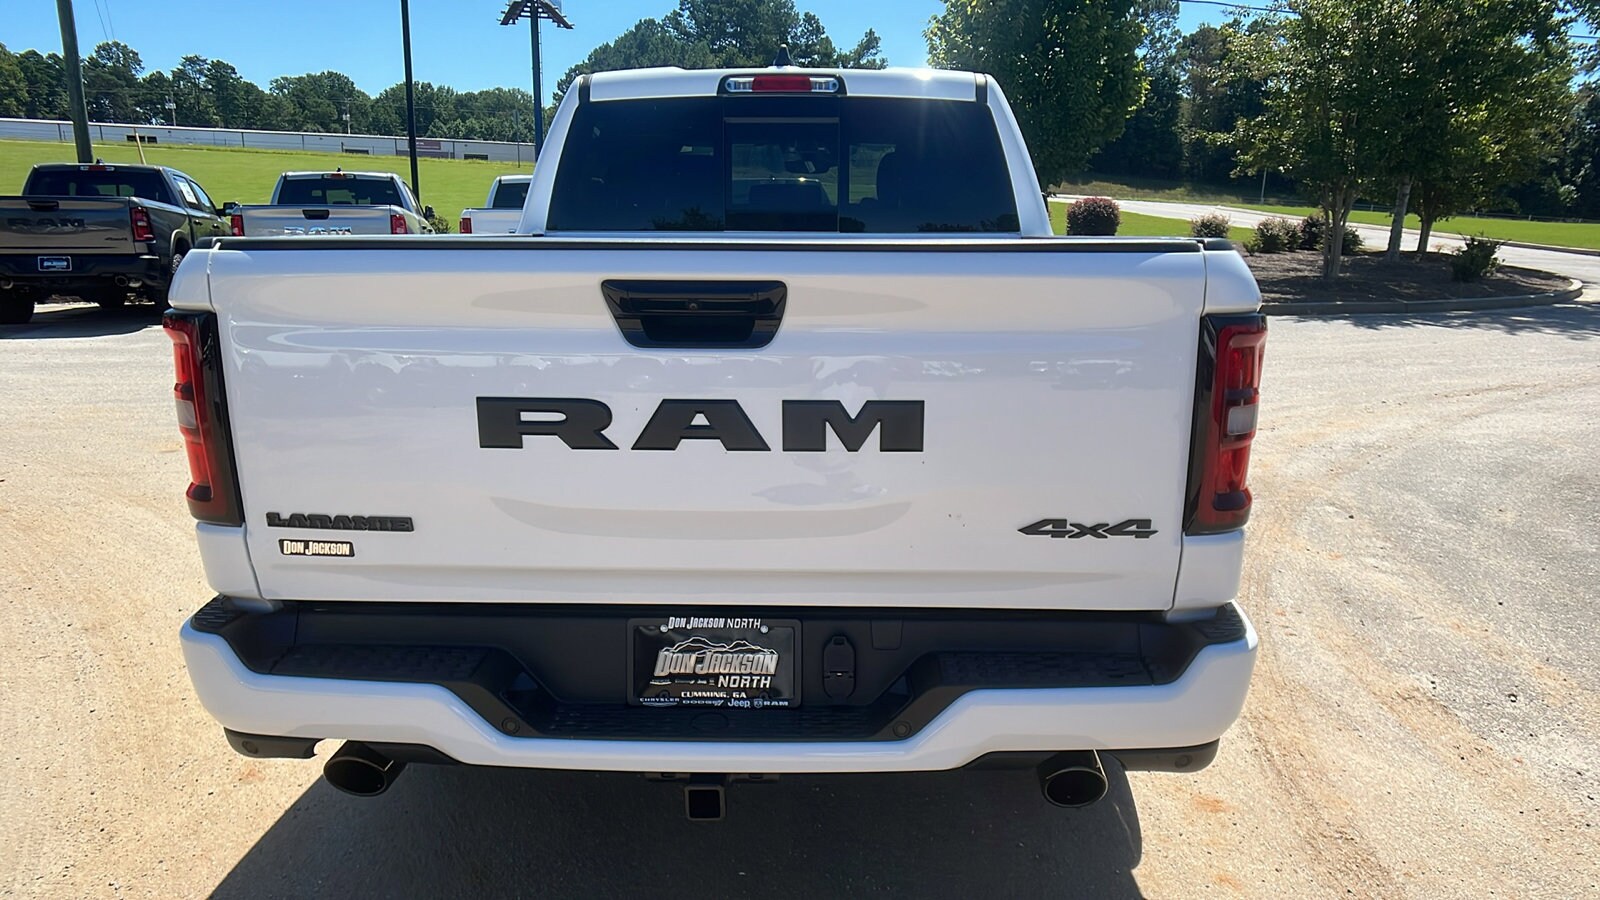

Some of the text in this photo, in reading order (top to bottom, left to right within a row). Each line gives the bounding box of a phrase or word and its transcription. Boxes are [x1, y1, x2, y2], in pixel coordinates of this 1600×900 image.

[476, 396, 925, 452] RAM
[266, 512, 414, 532] LARAMIE
[1017, 518, 1159, 539] 4x4
[726, 618, 761, 629] NORTH
[717, 675, 771, 688] NORTH
[732, 691, 747, 699] GA
[727, 698, 751, 709] Jeep
